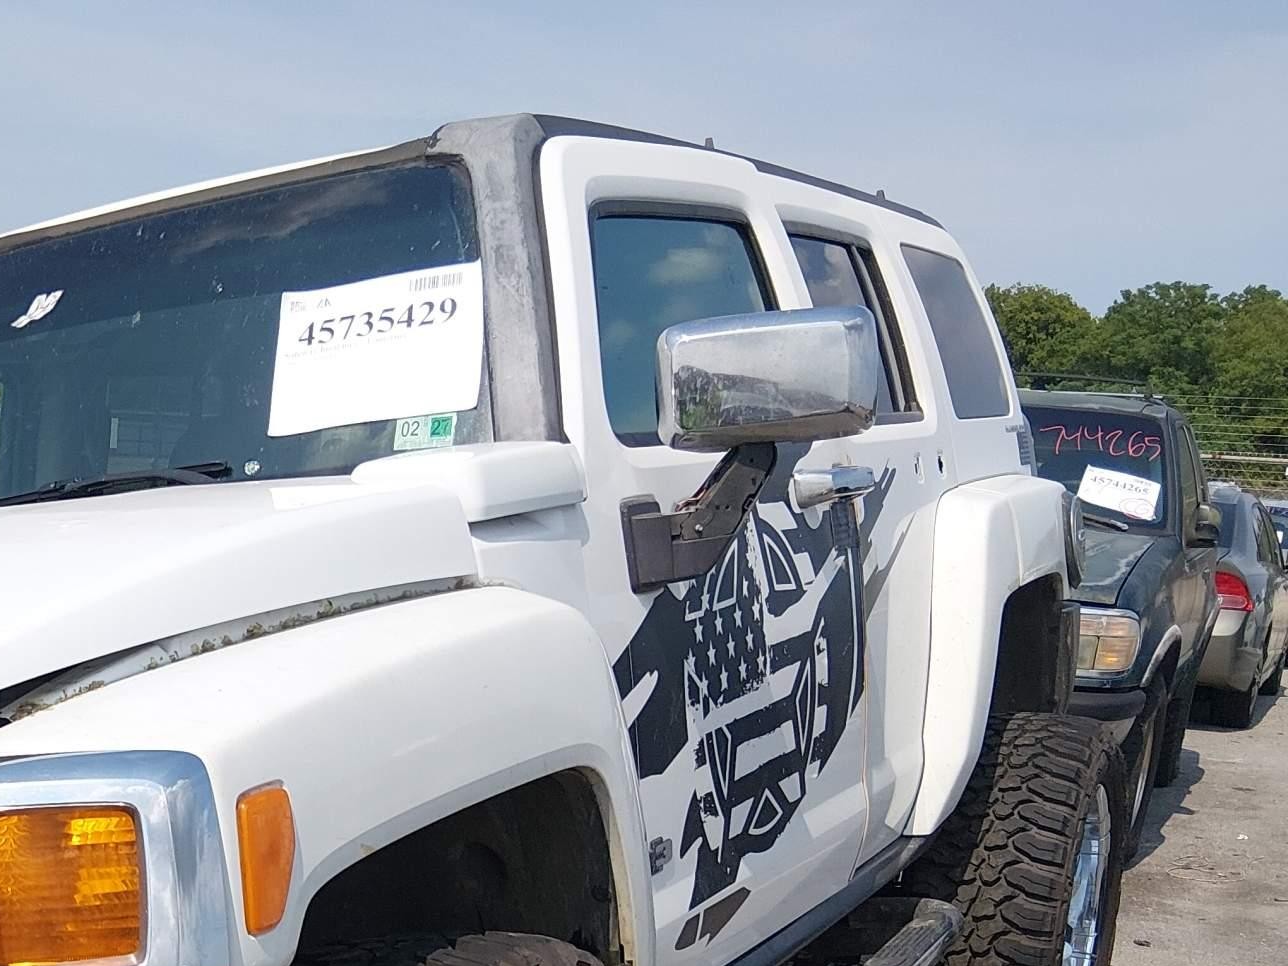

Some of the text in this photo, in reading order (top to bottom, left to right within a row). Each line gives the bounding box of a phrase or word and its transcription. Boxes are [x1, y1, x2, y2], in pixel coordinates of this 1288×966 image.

[298, 297, 458, 346] 45735429
[401, 417, 450, 438] 02 27
[1039, 425, 1161, 462] 744265
[1090, 475, 1150, 495] 45744265
